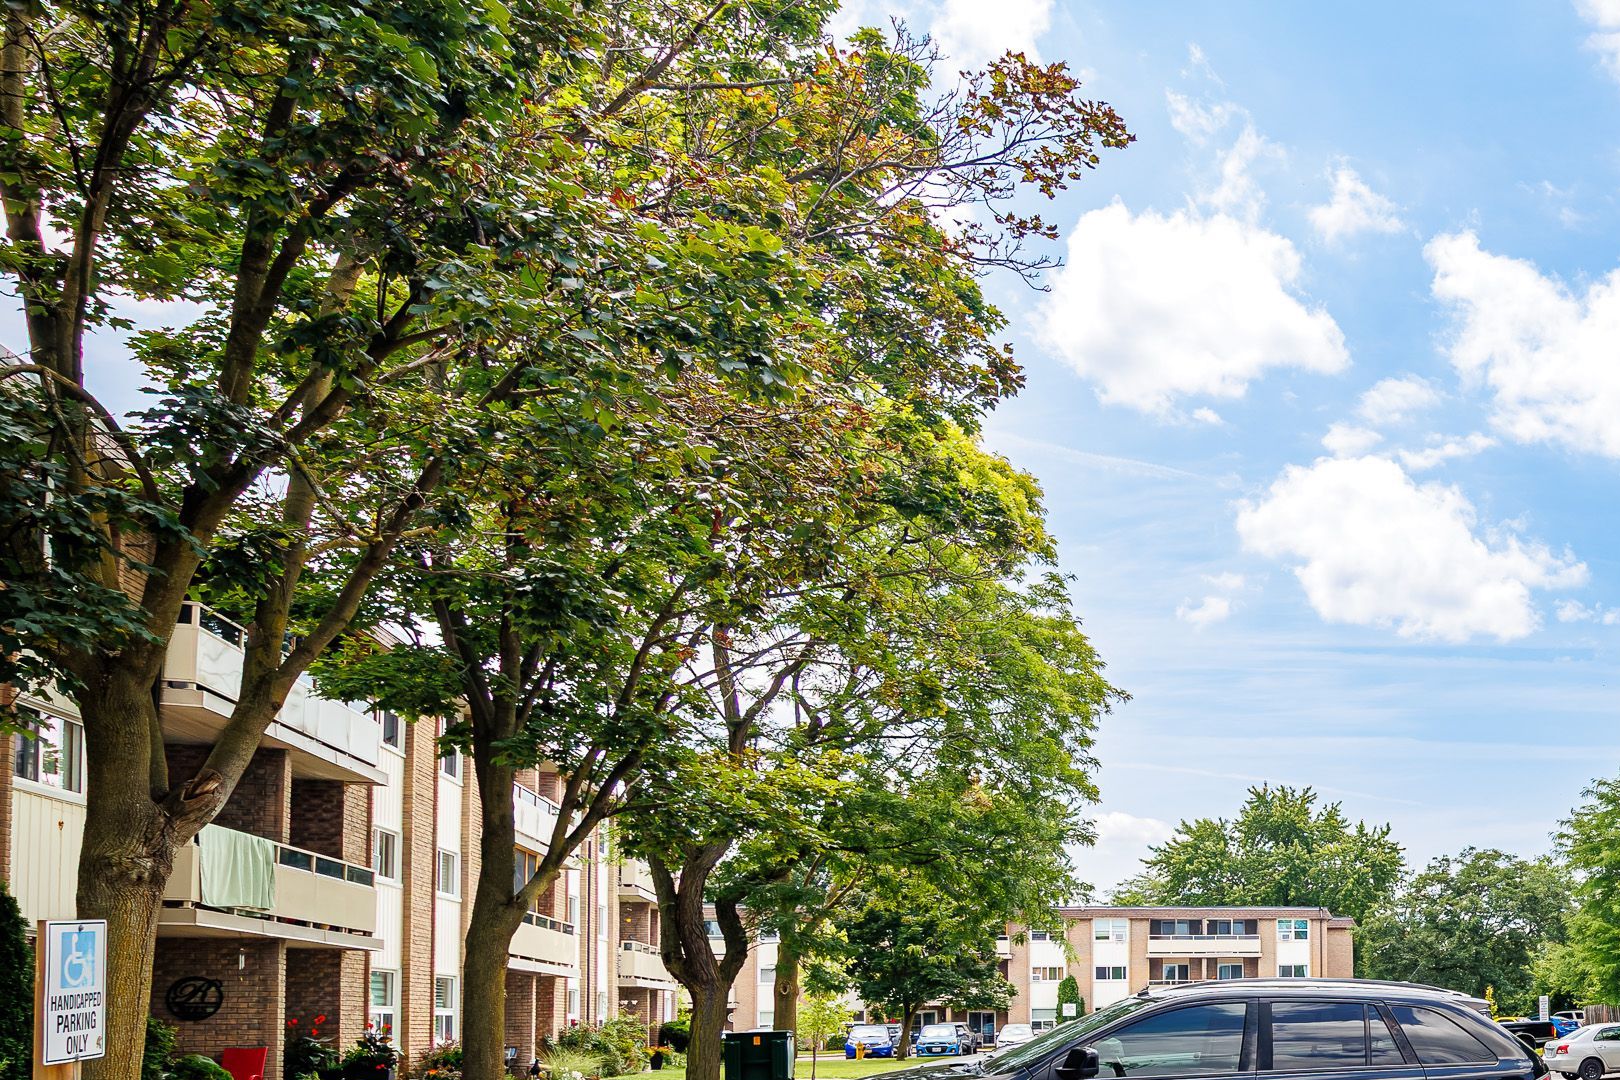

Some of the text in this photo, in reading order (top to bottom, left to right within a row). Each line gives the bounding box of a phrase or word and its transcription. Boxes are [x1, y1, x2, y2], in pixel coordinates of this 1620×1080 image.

[50, 991, 102, 1011] HANDICAPPED
[56, 1010, 97, 1034] PARKING
[66, 1033, 89, 1055] ONLY
